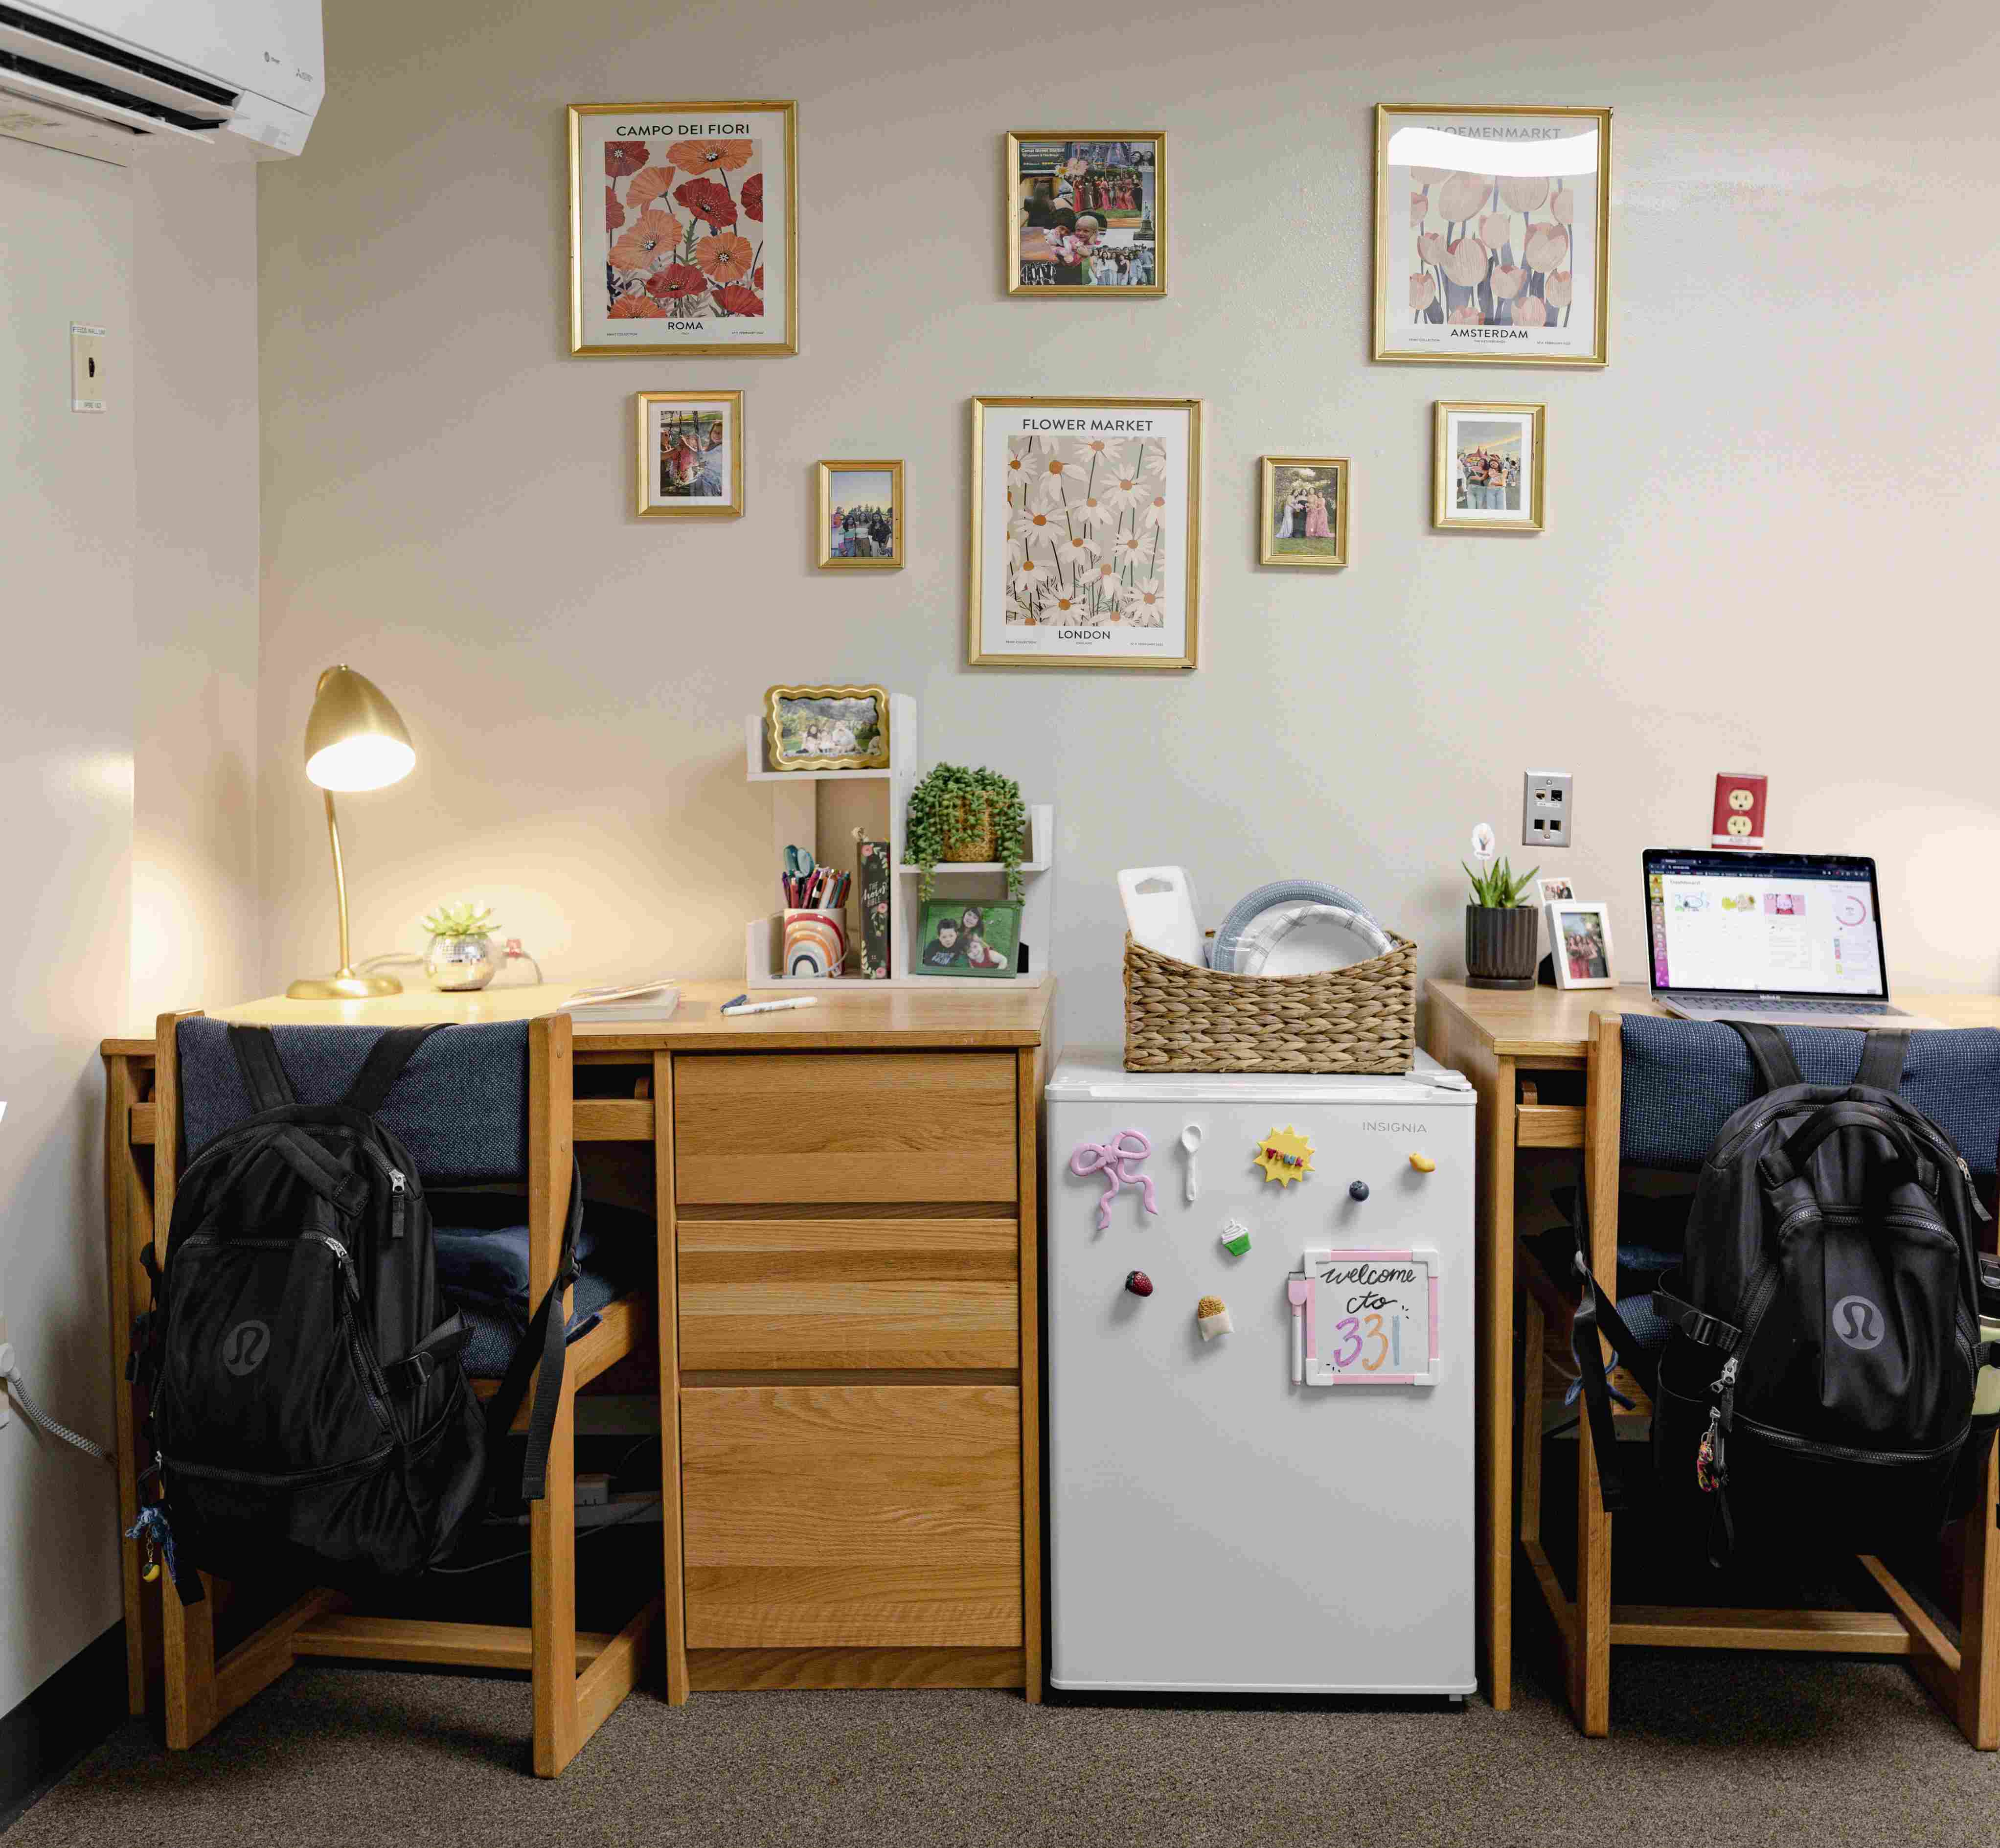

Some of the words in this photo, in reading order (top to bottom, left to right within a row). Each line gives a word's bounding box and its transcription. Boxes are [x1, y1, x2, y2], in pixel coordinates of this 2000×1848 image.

[616, 125, 674, 136] CAMPO
[679, 125, 703, 135] DEI
[708, 124, 750, 135] FIORI
[668, 321, 704, 330] ROMA
[1451, 329, 1528, 338] AMSTERDAM
[1023, 419, 1086, 430] FLOWER
[1091, 420, 1153, 431] MARKET
[1058, 630, 1110, 639] LONDON
[1363, 1122, 1427, 1133] INSIGNIA
[1320, 1264, 1416, 1285] welcome
[1333, 1313, 1401, 1371] 331
